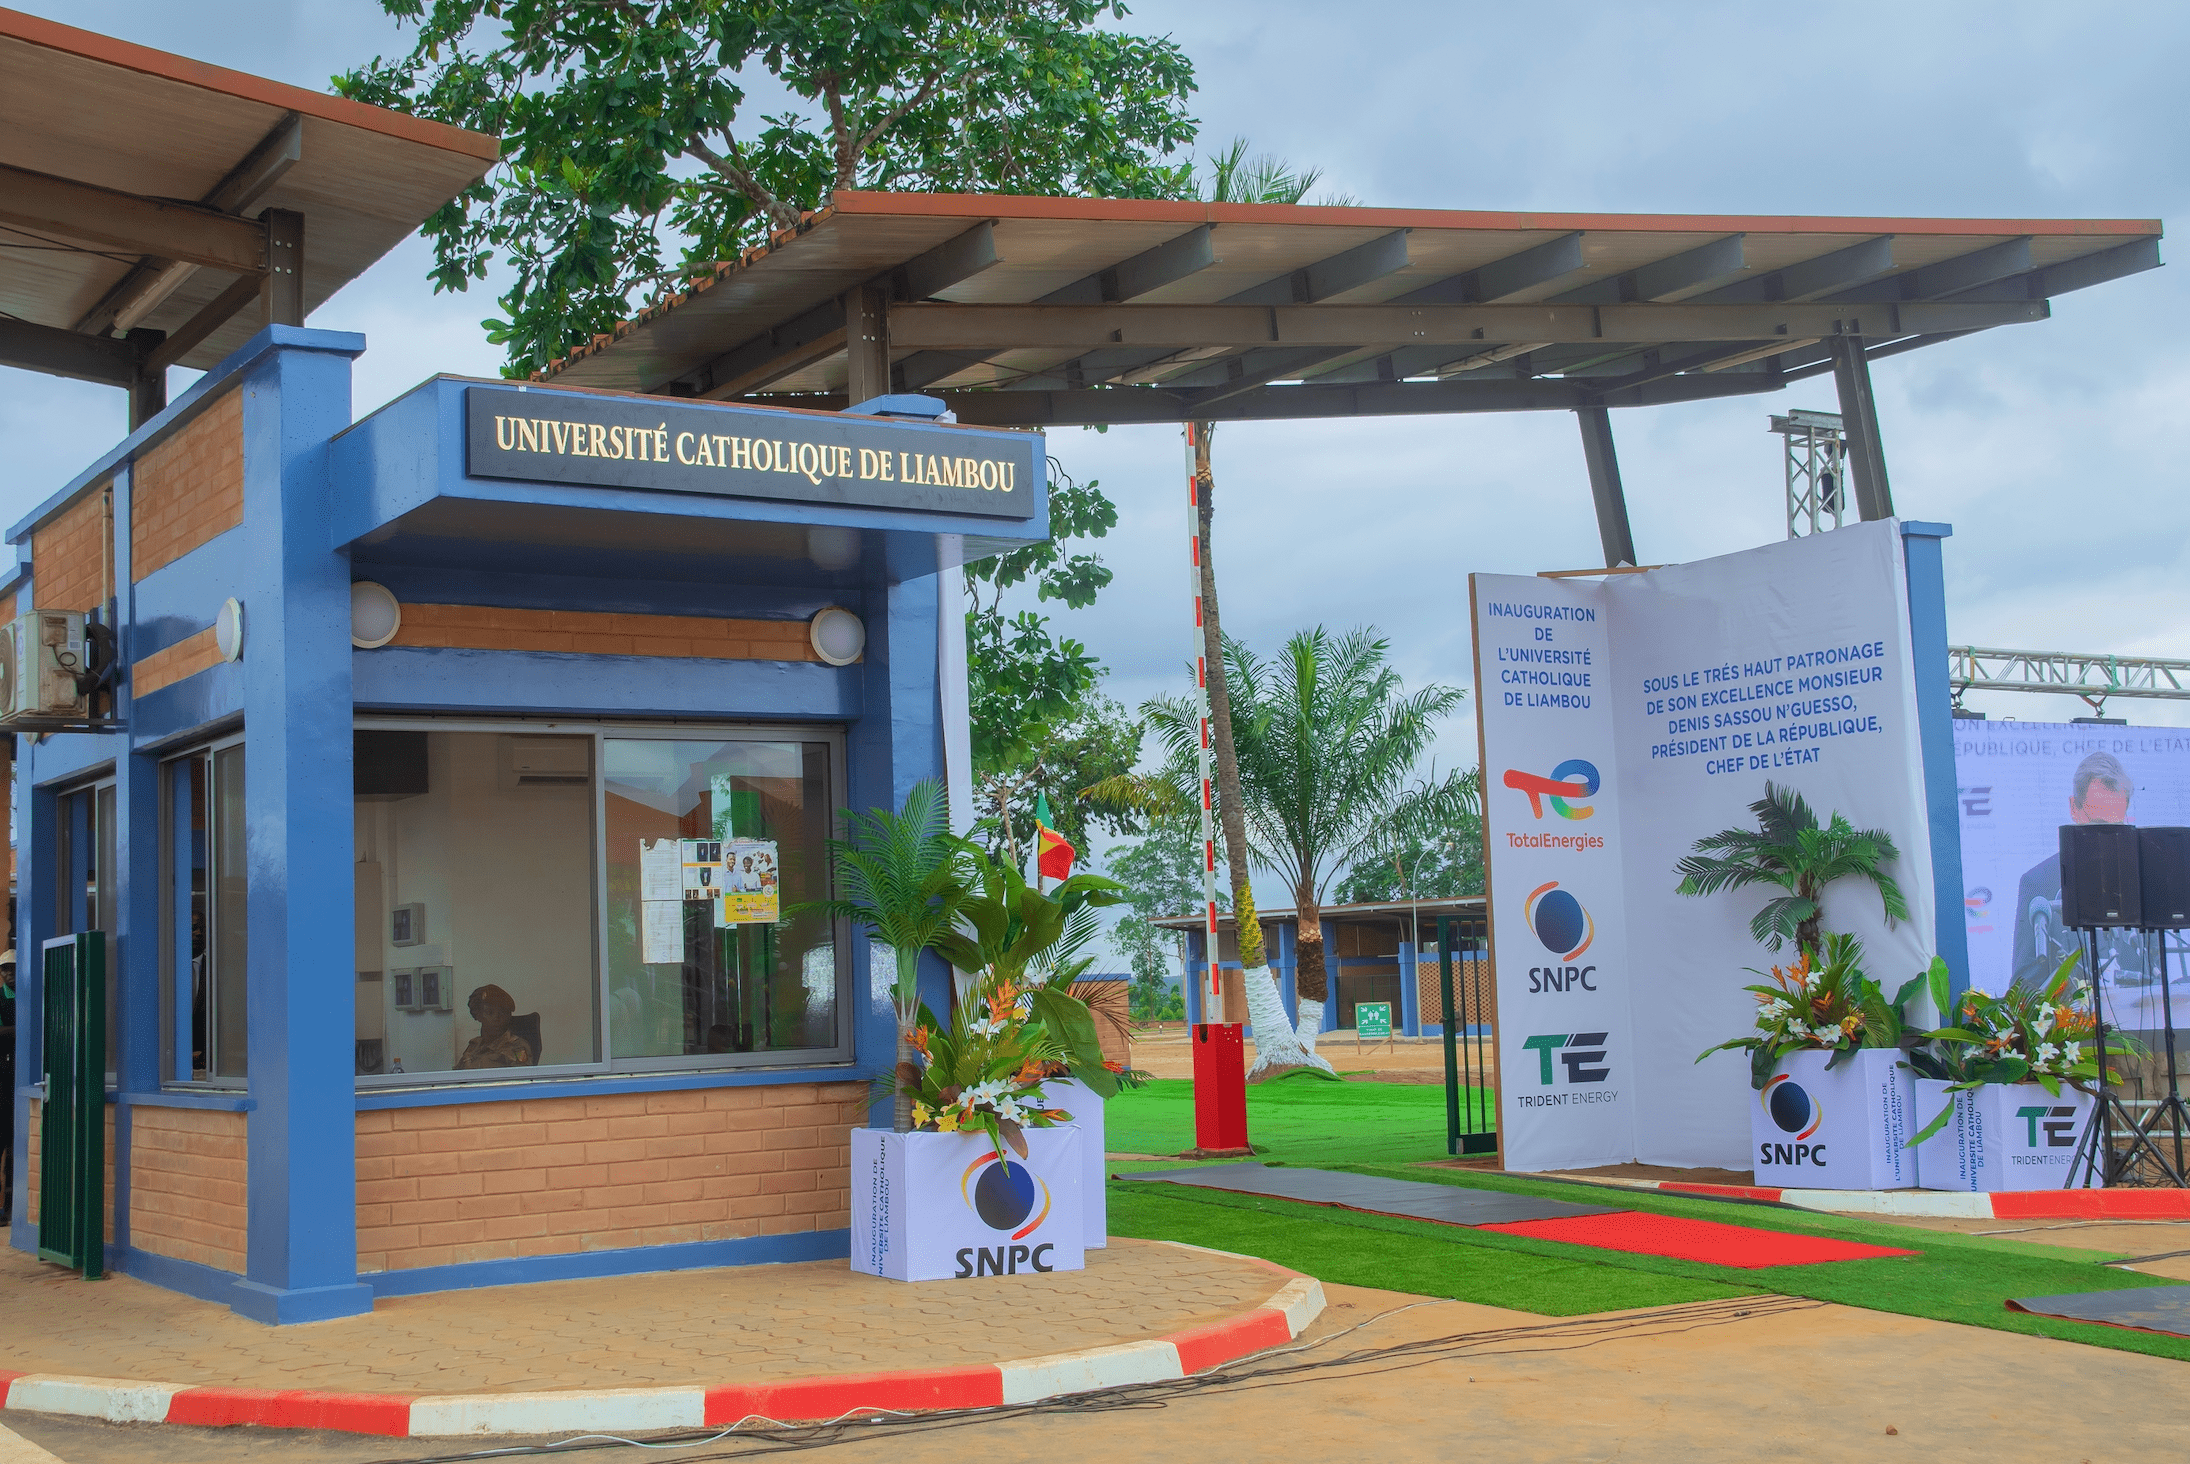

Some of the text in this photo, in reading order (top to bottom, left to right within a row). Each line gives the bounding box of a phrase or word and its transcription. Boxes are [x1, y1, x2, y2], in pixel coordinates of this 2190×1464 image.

[495, 415, 1015, 493] UNIVERSITÉ CATHOLIQUE DE LIAMBOU
[1488, 602, 1595, 622] INAUGURATION
[1535, 627, 1553, 641] DE
[1501, 669, 1591, 687] CATHOLIQUE
[1643, 641, 1884, 693] SOUS LE TRÉS HAUT PATRONAGE
[1504, 692, 1591, 709] DE LIAMBOU
[1646, 666, 1882, 715] DE SON EXCELLENCE MONSIEUR
[1668, 715, 1710, 735] DENIS
[1714, 707, 1772, 728] SASSOU
[1955, 719, 1979, 731] ON
[1651, 715, 1882, 759] PRÉSIDENT DE LA RÉPUBLIQUE,
[1955, 737, 2056, 757] ÉPUBLIQUE,
[2113, 740, 2133, 753] DE
[1706, 757, 1744, 775] CHEF
[1750, 754, 1769, 770] DE
[1506, 832, 1604, 852] TotalEnergies
[1528, 965, 1597, 994] SNPC
[1518, 1090, 1619, 1108] TRIDENT ENERGY
[1889, 1064, 1898, 1121] CATHOLIQUE
[1882, 1083, 1891, 1164] INAUGURATION DE
[1896, 1095, 1905, 1150] DE LIAMBOU
[1956, 1097, 1966, 1180] INAUGURATION DE
[1967, 1087, 1978, 1192] UNIVERSITE CATHOLIQ
[1975, 1111, 1984, 1167] DE LIAMBOU
[872, 1158, 878, 1174] DE
[1761, 1143, 1827, 1167] SNPC
[2011, 1155, 2075, 1165] TRIDENT ENER
[884, 1235, 889, 1252] DE
[955, 1243, 1054, 1278] SNPC
